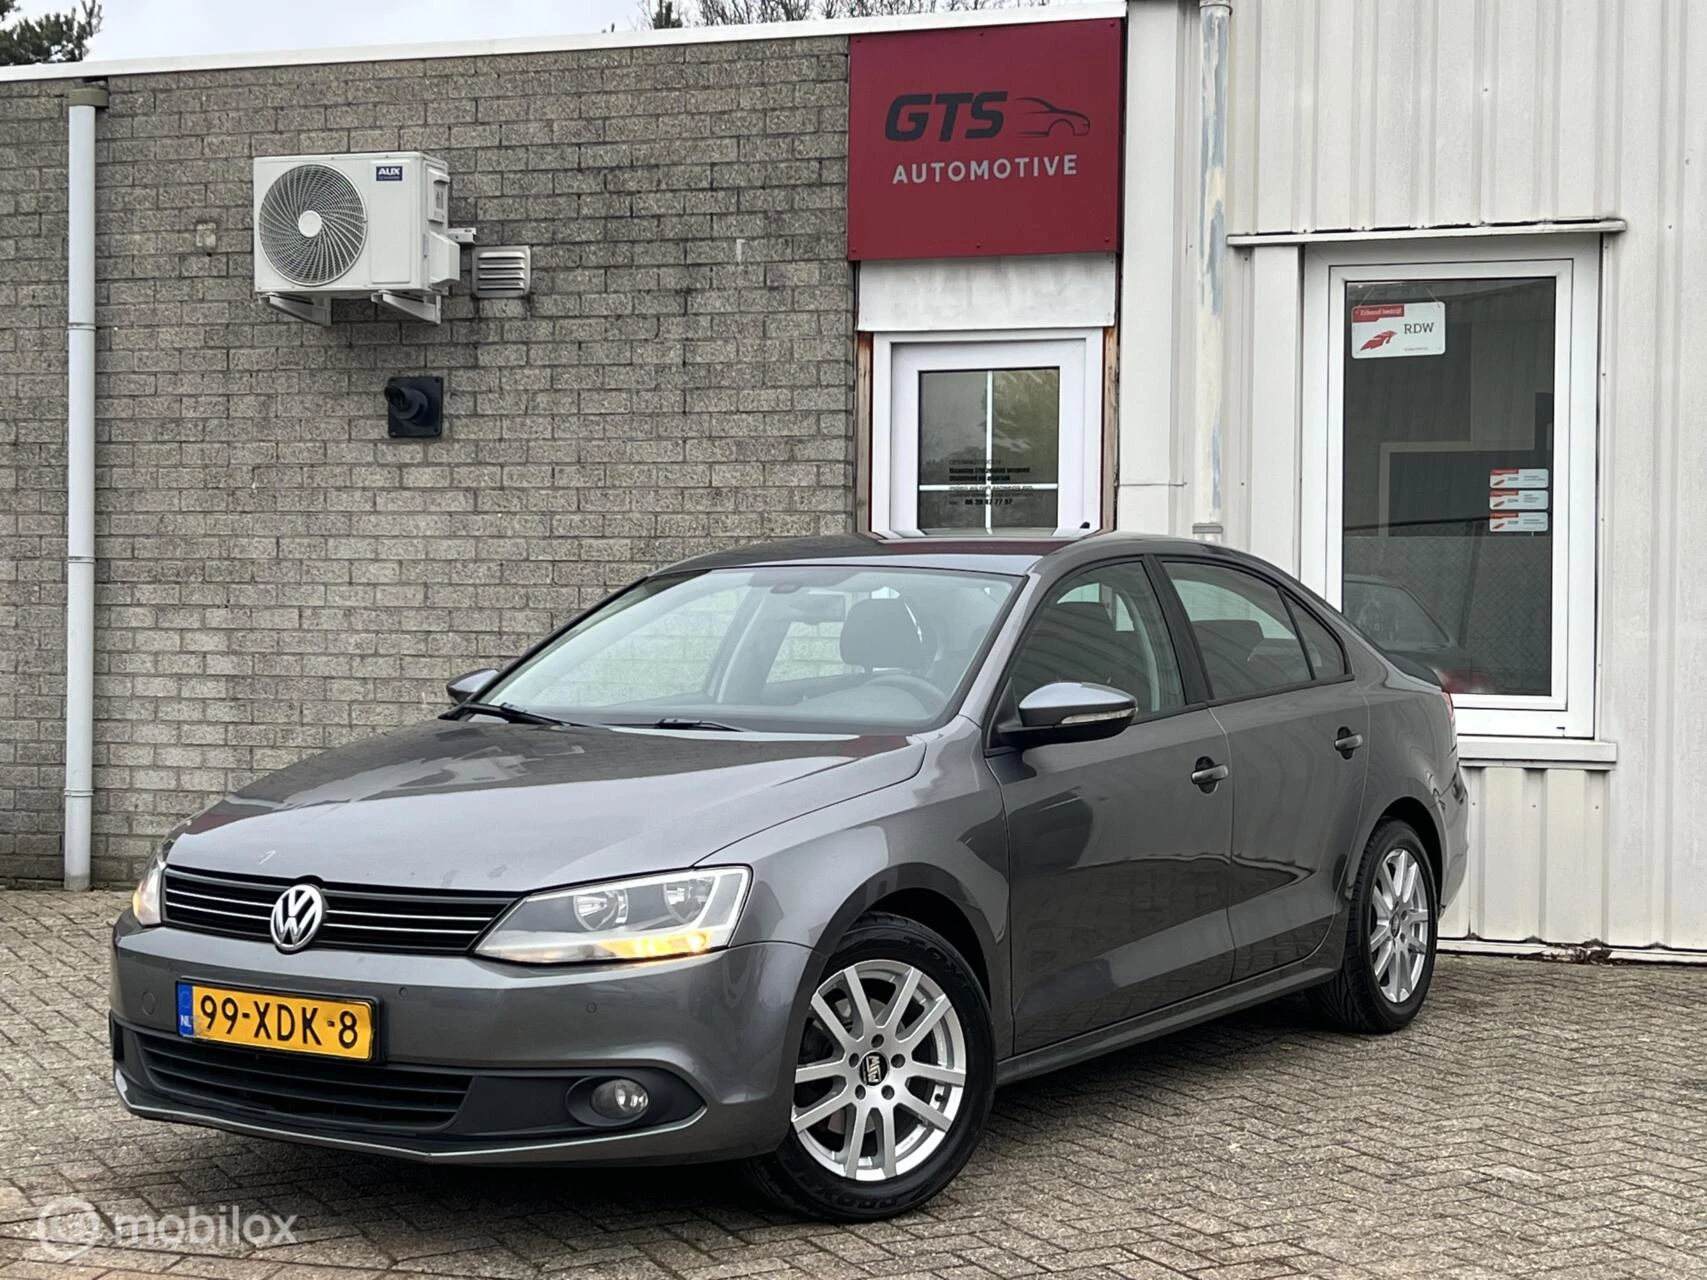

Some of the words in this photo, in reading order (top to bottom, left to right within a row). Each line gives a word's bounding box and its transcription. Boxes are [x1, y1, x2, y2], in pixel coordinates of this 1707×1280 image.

[884, 91, 1008, 142] GTS
[892, 154, 1077, 184] AUTOMOTIVE
[1404, 322, 1435, 334] RDW
[180, 1014, 192, 1028] NL
[200, 994, 358, 1050] 99-XDK-8
